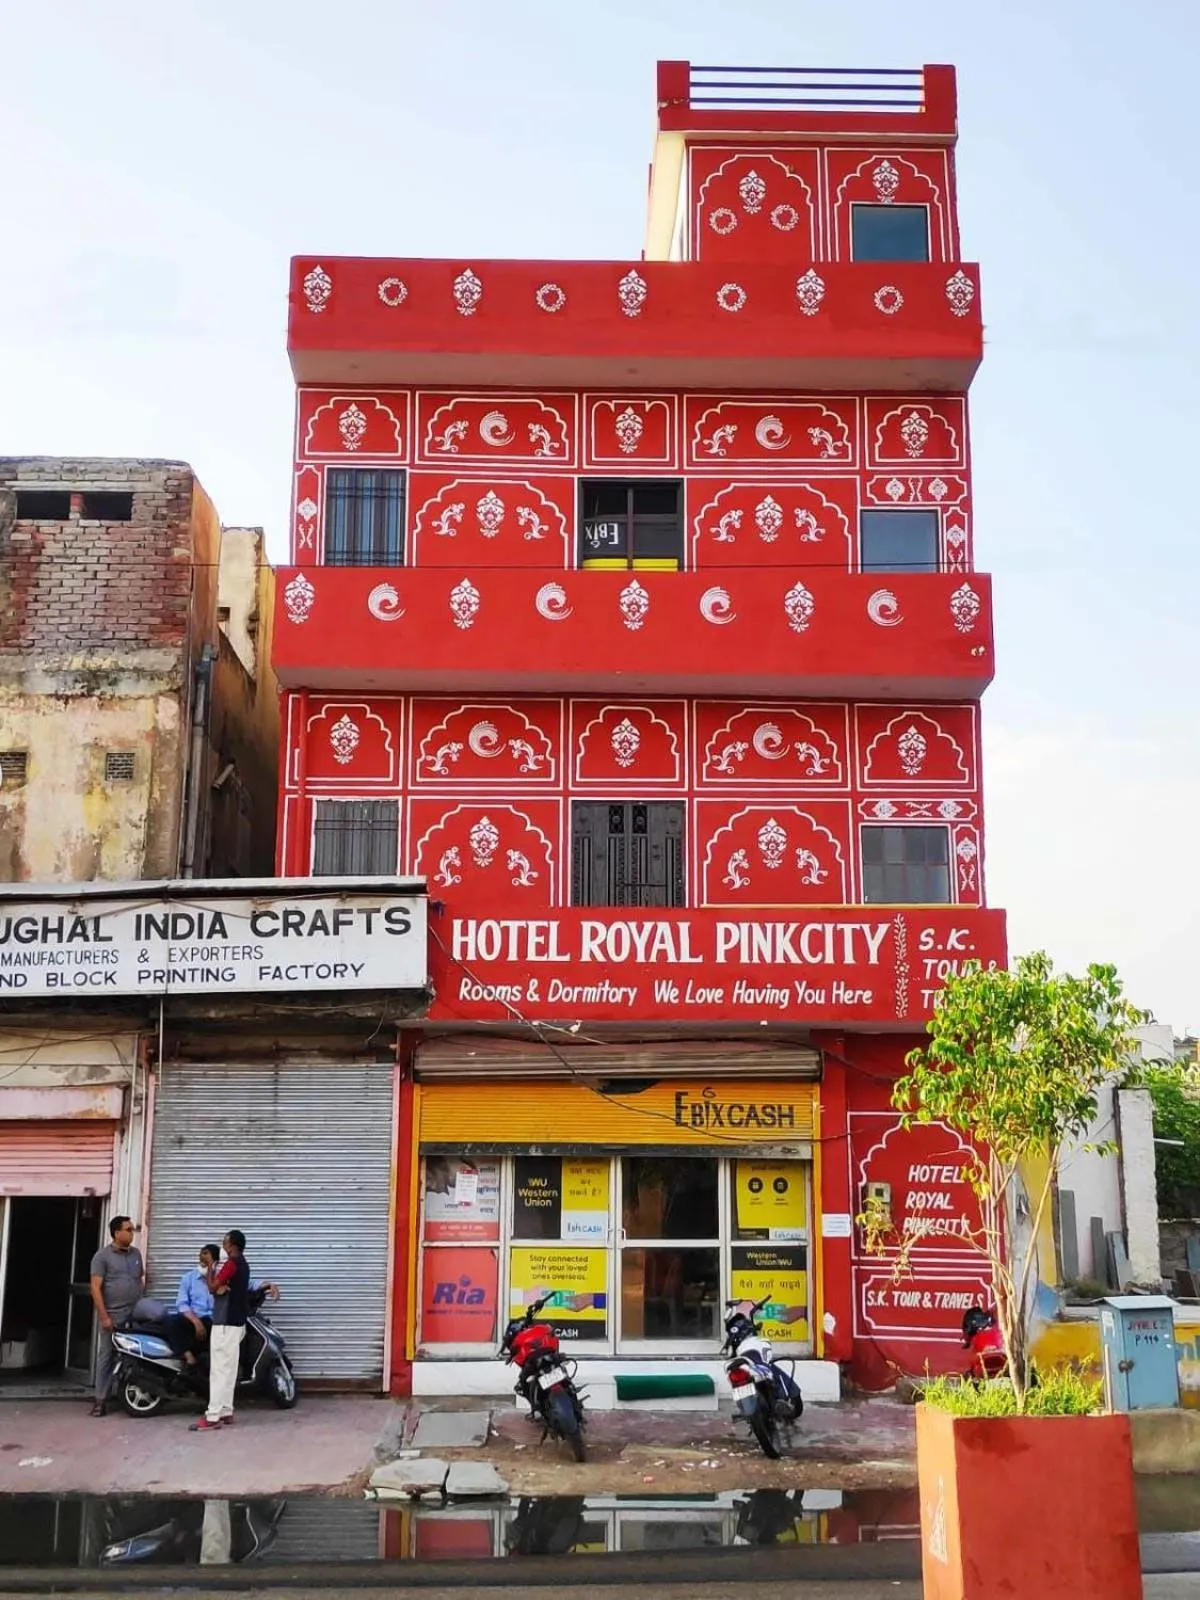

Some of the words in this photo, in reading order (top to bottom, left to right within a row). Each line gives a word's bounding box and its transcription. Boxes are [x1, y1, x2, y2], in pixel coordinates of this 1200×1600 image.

[135, 911, 228, 942] INDIA
[250, 906, 411, 938] CRAFTS
[452, 919, 571, 962] HOTEL
[579, 921, 703, 963] ROYAL
[715, 921, 890, 965] PINKCITY
[918, 927, 975, 950] S.K.
[1, 948, 119, 967] MANUFACTURERS
[137, 948, 150, 963] &
[168, 945, 264, 963] EXPORTERS
[46, 970, 117, 987] BLOCK
[138, 967, 236, 985] PRINTING
[259, 962, 365, 981] FACTORY
[459, 977, 522, 1001] Rooms
[526, 978, 540, 1002] &
[547, 978, 637, 1006] Dormitory
[654, 979, 679, 1004] We
[685, 979, 724, 1004] Love
[733, 980, 789, 1009] Having
[795, 980, 825, 1005] You
[832, 981, 873, 1005] Here
[908, 1165, 964, 1183] HOTEL
[518, 1188, 559, 1198] Western
[905, 1191, 954, 1209] ROYAL
[524, 1198, 553, 1208] Union
[529, 1254, 546, 1263] Stay
[547, 1254, 589, 1263] connected
[746, 1252, 777, 1260] Western
[531, 1264, 547, 1272] with
[566, 1264, 588, 1272] loved
[433, 1274, 485, 1305] Ria
[867, 1290, 889, 1306] S.K.
[892, 1291, 921, 1308] TOUR
[922, 1291, 933, 1308] &
[933, 1292, 984, 1309] TRAVELS
